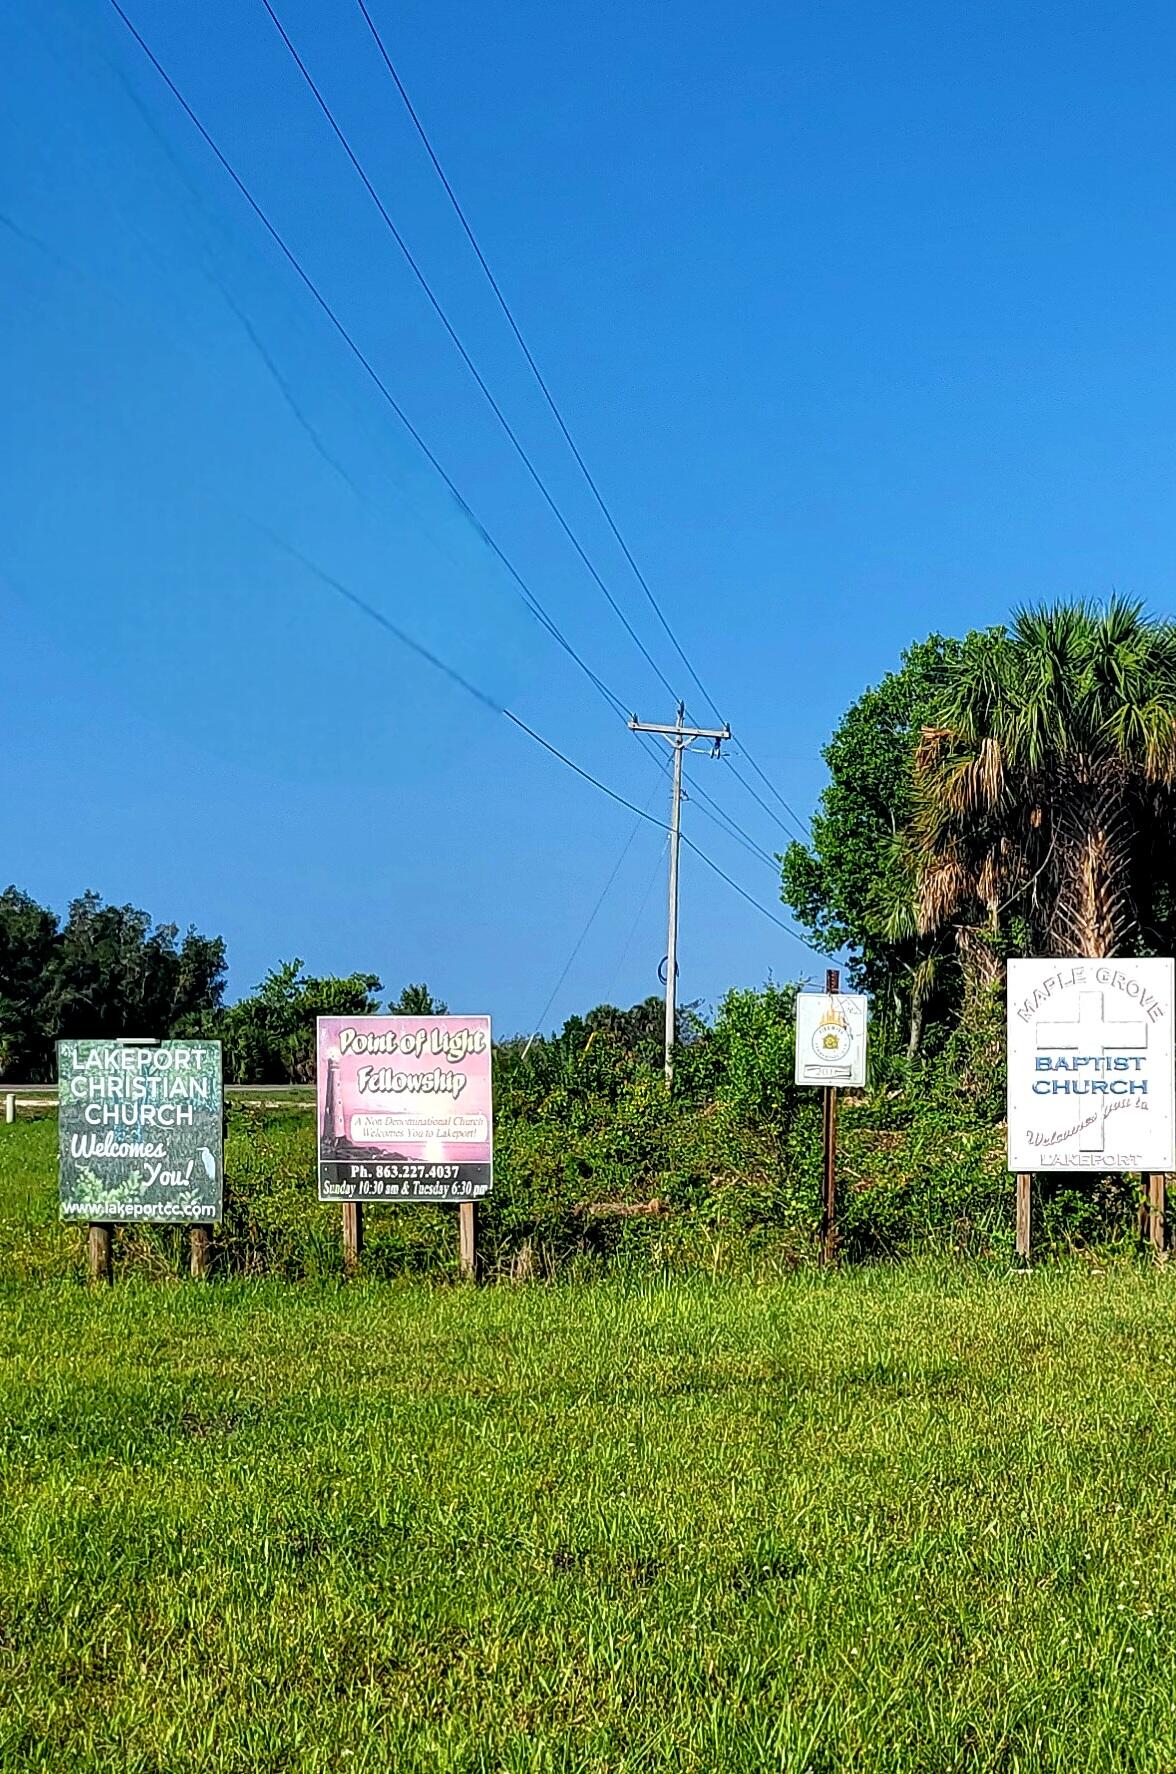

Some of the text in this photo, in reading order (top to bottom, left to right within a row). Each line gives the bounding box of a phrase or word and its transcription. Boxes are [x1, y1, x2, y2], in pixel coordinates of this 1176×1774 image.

[1017, 966, 1164, 1023] MAPLE GROVE
[339, 1027, 487, 1063] Point of Light
[72, 1048, 207, 1070] LAKEPORT
[1035, 1056, 1147, 1071] BAPTIST
[70, 1076, 208, 1098] CHRISTIAN
[357, 1065, 467, 1099] Fellowship
[1032, 1079, 1148, 1095] CHURCH
[85, 1104, 193, 1125] CHURCH
[354, 1117, 362, 1126] A
[364, 1117, 383, 1126] Non
[453, 1116, 484, 1126] Church
[363, 1128, 404, 1138] Welcomes
[407, 1128, 423, 1138] You
[425, 1129, 434, 1138] to
[71, 1131, 167, 1158] Welcomes
[1040, 1153, 1142, 1166] LAKEPORT
[142, 1160, 194, 1187] You!
[350, 1165, 460, 1179] Ph. 863.227.4037
[323, 1180, 489, 1198] Sunday 10:30 am & Tuesday 6:30 pm
[62, 1200, 216, 1217] www.lakeportcc.com
